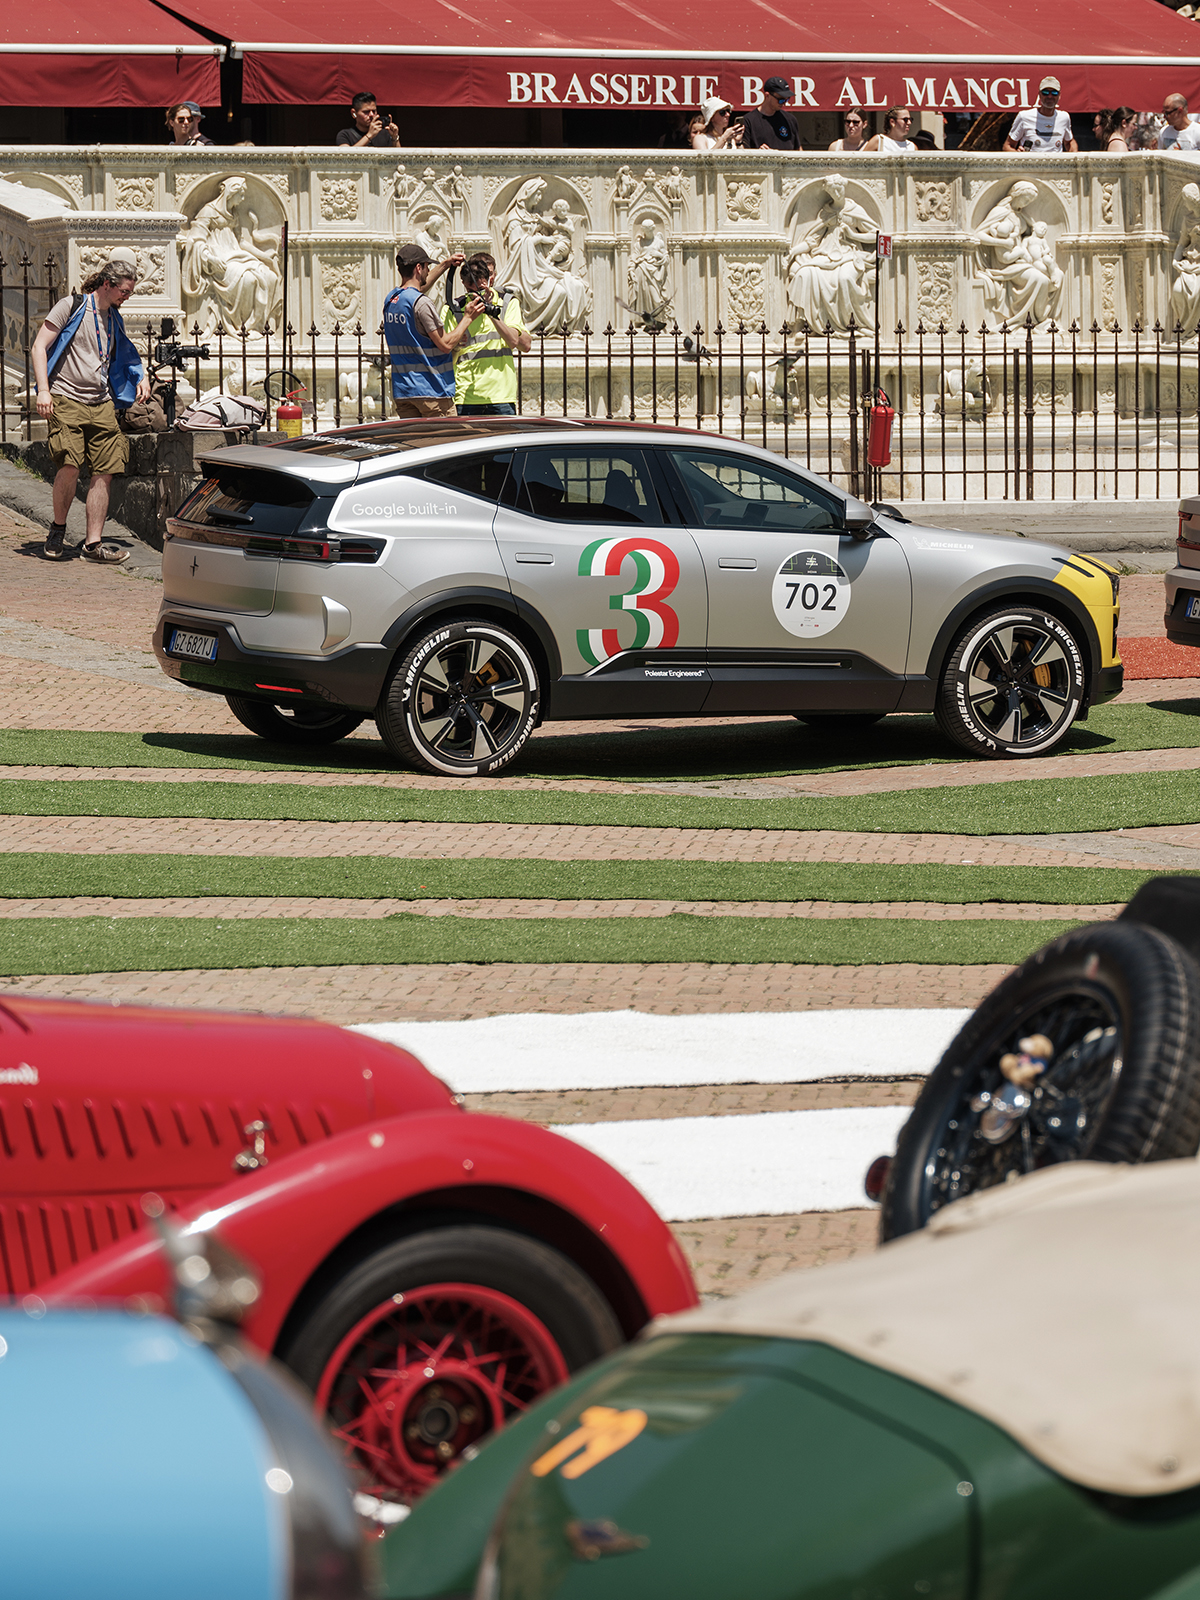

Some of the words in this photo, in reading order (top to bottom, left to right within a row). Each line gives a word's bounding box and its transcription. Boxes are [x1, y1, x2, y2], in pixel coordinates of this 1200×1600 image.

[507, 72, 719, 106] BRASSERIE
[740, 76, 820, 107] BR
[836, 76, 888, 107] AL
[351, 502, 405, 518] Google
[408, 502, 457, 516] built-in
[930, 541, 974, 550] MICHELIN
[576, 537, 680, 667] 3
[785, 582, 837, 611] 702
[405, 629, 451, 687] MICHELIN
[1054, 624, 1083, 687] MICHELIN
[956, 681, 987, 743] MICHELIN
[488, 716, 535, 772] MICHELIN
